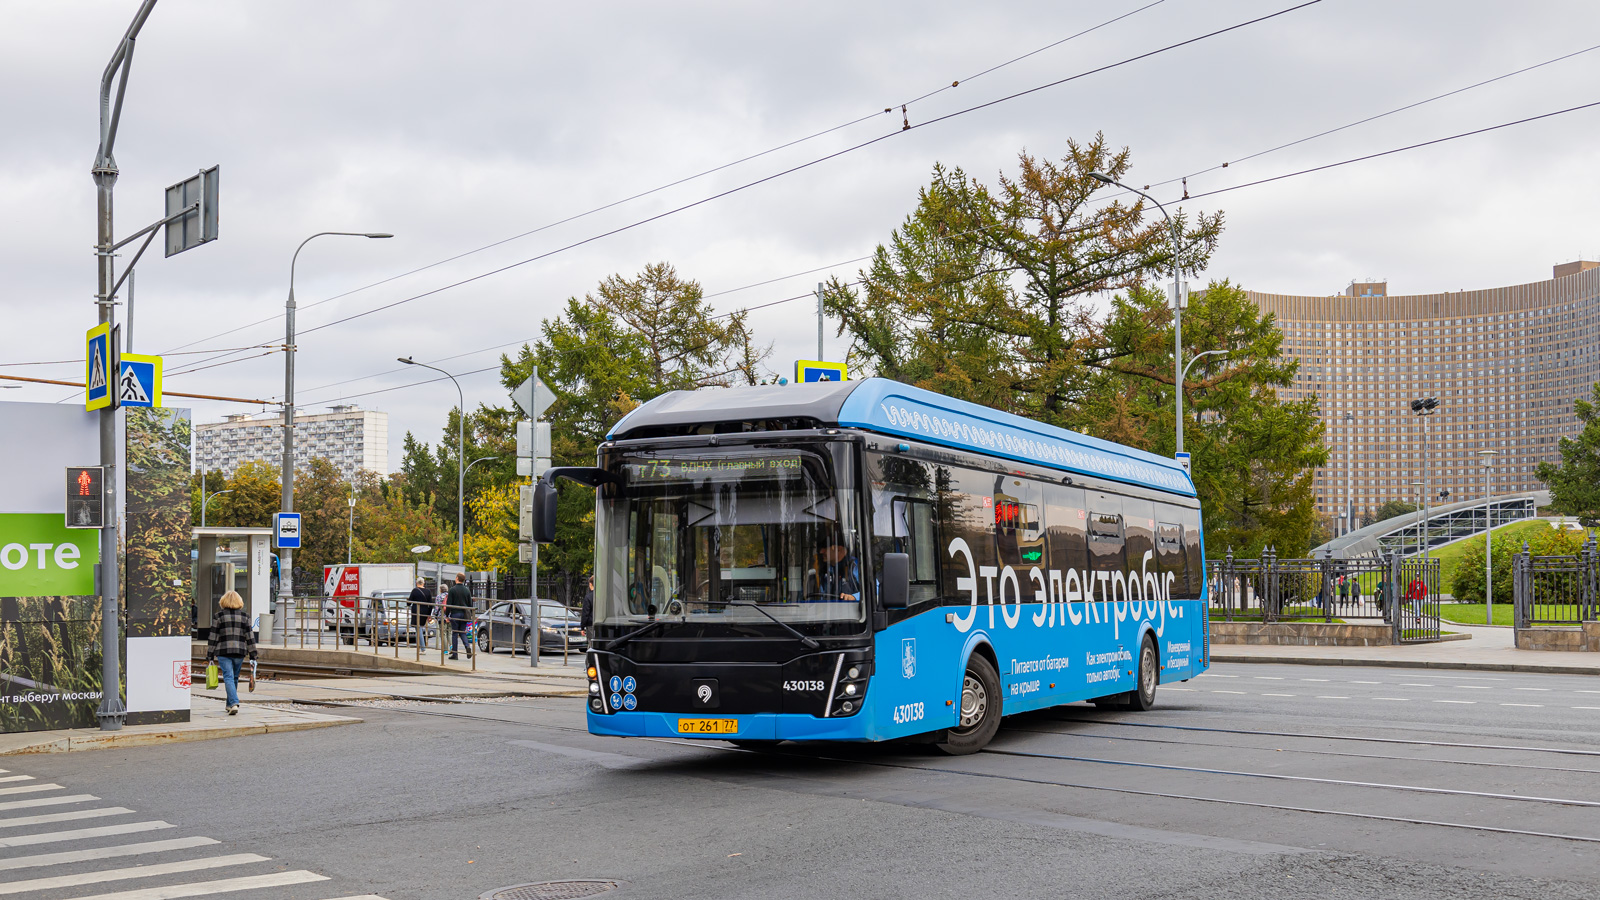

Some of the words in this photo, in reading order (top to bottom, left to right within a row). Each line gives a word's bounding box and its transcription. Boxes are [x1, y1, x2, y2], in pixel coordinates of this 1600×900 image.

[681, 461, 713, 473] ВДНХ
[718, 458, 765, 471] (главный
[769, 456, 802, 470] вход)
[0, 542, 80, 570] оте
[948, 537, 1020, 632] Это
[1029, 549, 1183, 640] электробус.
[1011, 658, 1039, 675] Питается
[1039, 660, 1047, 671] от
[1047, 654, 1069, 672] батареи
[1086, 652, 1096, 666] Как
[1086, 670, 1103, 684] только
[1103, 665, 1120, 682] автобус
[783, 681, 825, 691] 430138
[1010, 683, 1019, 695] на
[1019, 680, 1041, 697] крыше
[13, 691, 60, 704] выберут
[893, 702, 925, 724] 430138
[700, 721, 718, 731] 261
[724, 720, 734, 728] 77
